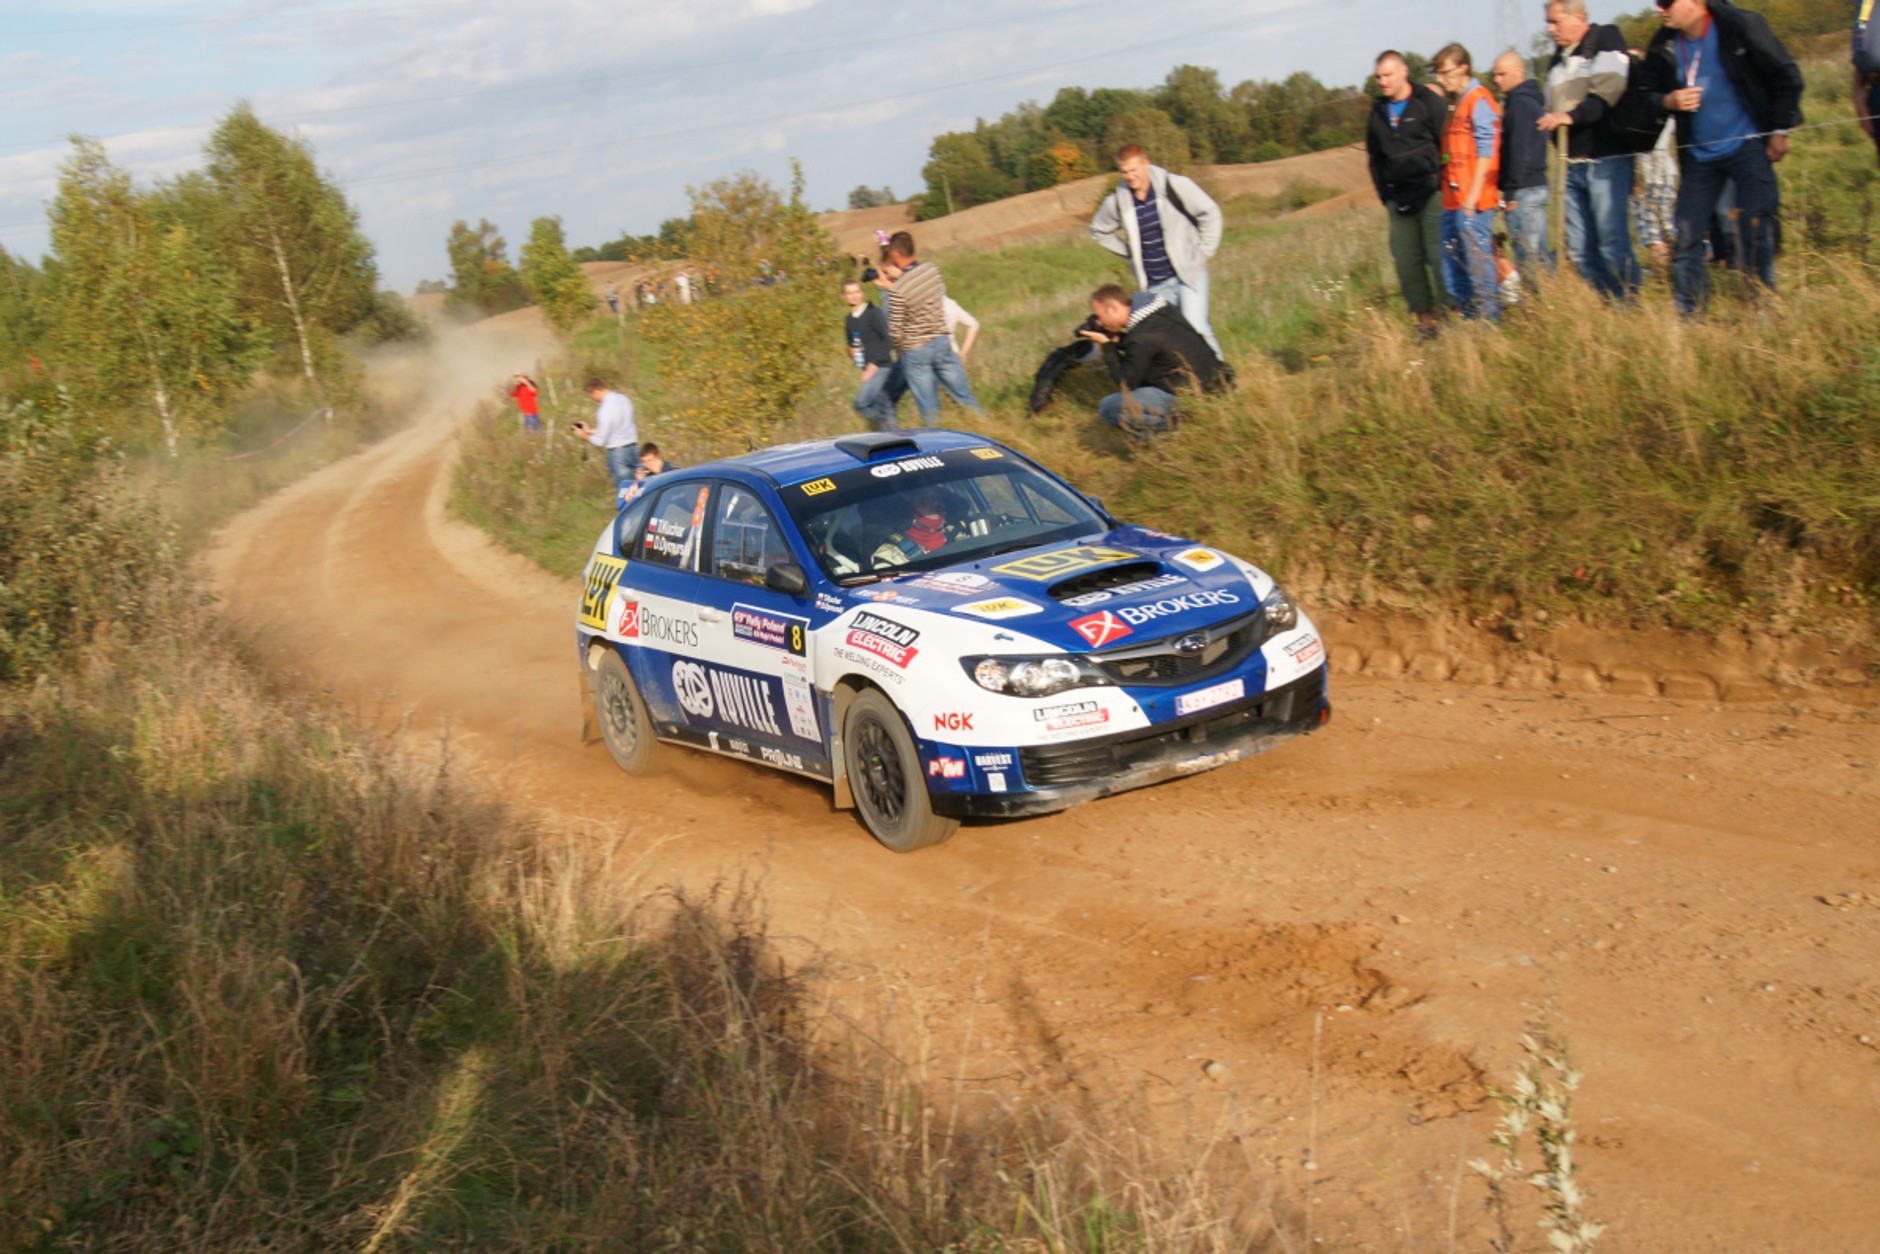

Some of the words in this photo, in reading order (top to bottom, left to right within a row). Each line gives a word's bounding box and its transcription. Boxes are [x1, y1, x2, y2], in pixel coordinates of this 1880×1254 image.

[1117, 589, 1240, 626] BROKERS
[641, 606, 698, 648] BROKERS
[791, 625, 802, 650] 8
[852, 612, 916, 646] LINCOLN
[853, 633, 907, 663] ELECTRIC
[709, 669, 783, 737] RUVILLE
[934, 713, 974, 731] NGK
